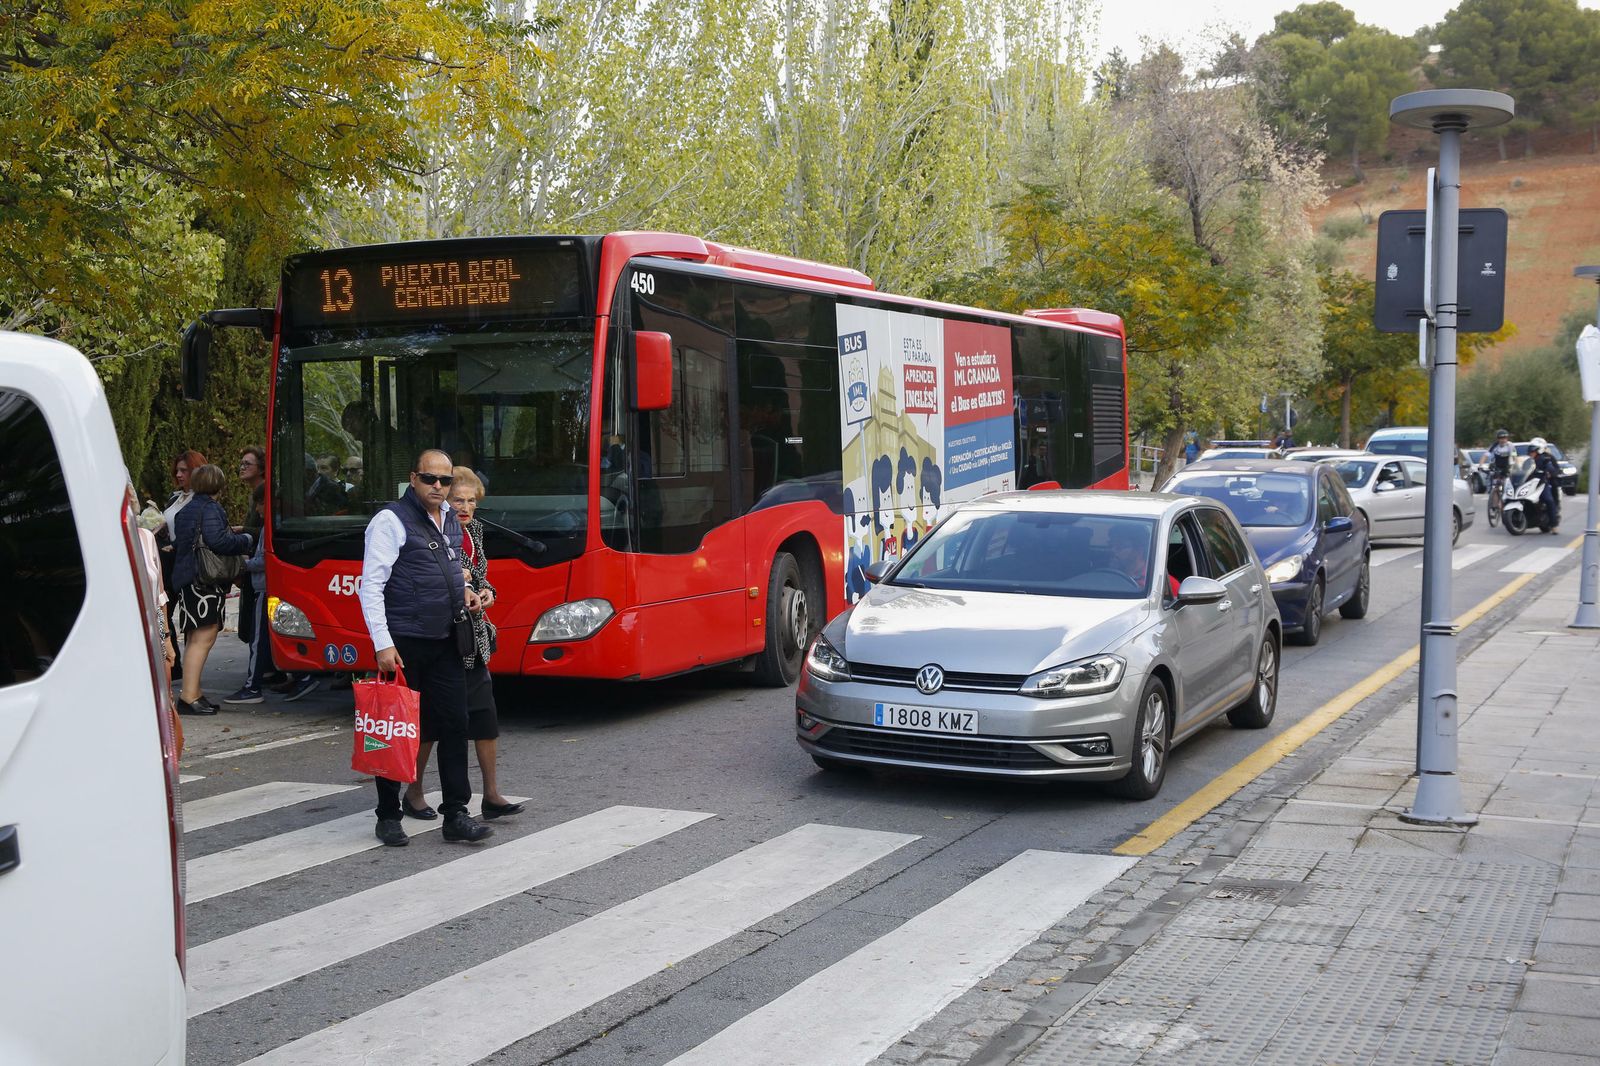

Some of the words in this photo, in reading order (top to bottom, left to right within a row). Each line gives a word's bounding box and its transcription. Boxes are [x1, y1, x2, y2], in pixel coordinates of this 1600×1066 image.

[381, 262, 460, 287] PUERTA
[468, 258, 520, 280] REAL
[320, 268, 354, 312] 13
[630, 272, 654, 294] 450
[394, 282, 510, 308] CEMENTERIO
[844, 335, 862, 352] BUS
[904, 338, 916, 350] ESTA
[916, 339, 922, 350] ES
[904, 350, 911, 361] TU
[912, 351, 932, 363] PARADA
[954, 352, 966, 366] Ven
[966, 355, 970, 366] a
[971, 350, 992, 365] estudiar
[993, 354, 996, 364] a
[905, 370, 935, 384] APRENDER
[954, 369, 966, 386] IML
[967, 367, 1000, 385] GRANADA
[951, 396, 957, 413] el
[958, 396, 970, 411] Bus
[971, 397, 978, 409] es
[889, 707, 931, 728] 1808
[938, 712, 974, 731] KMZ
